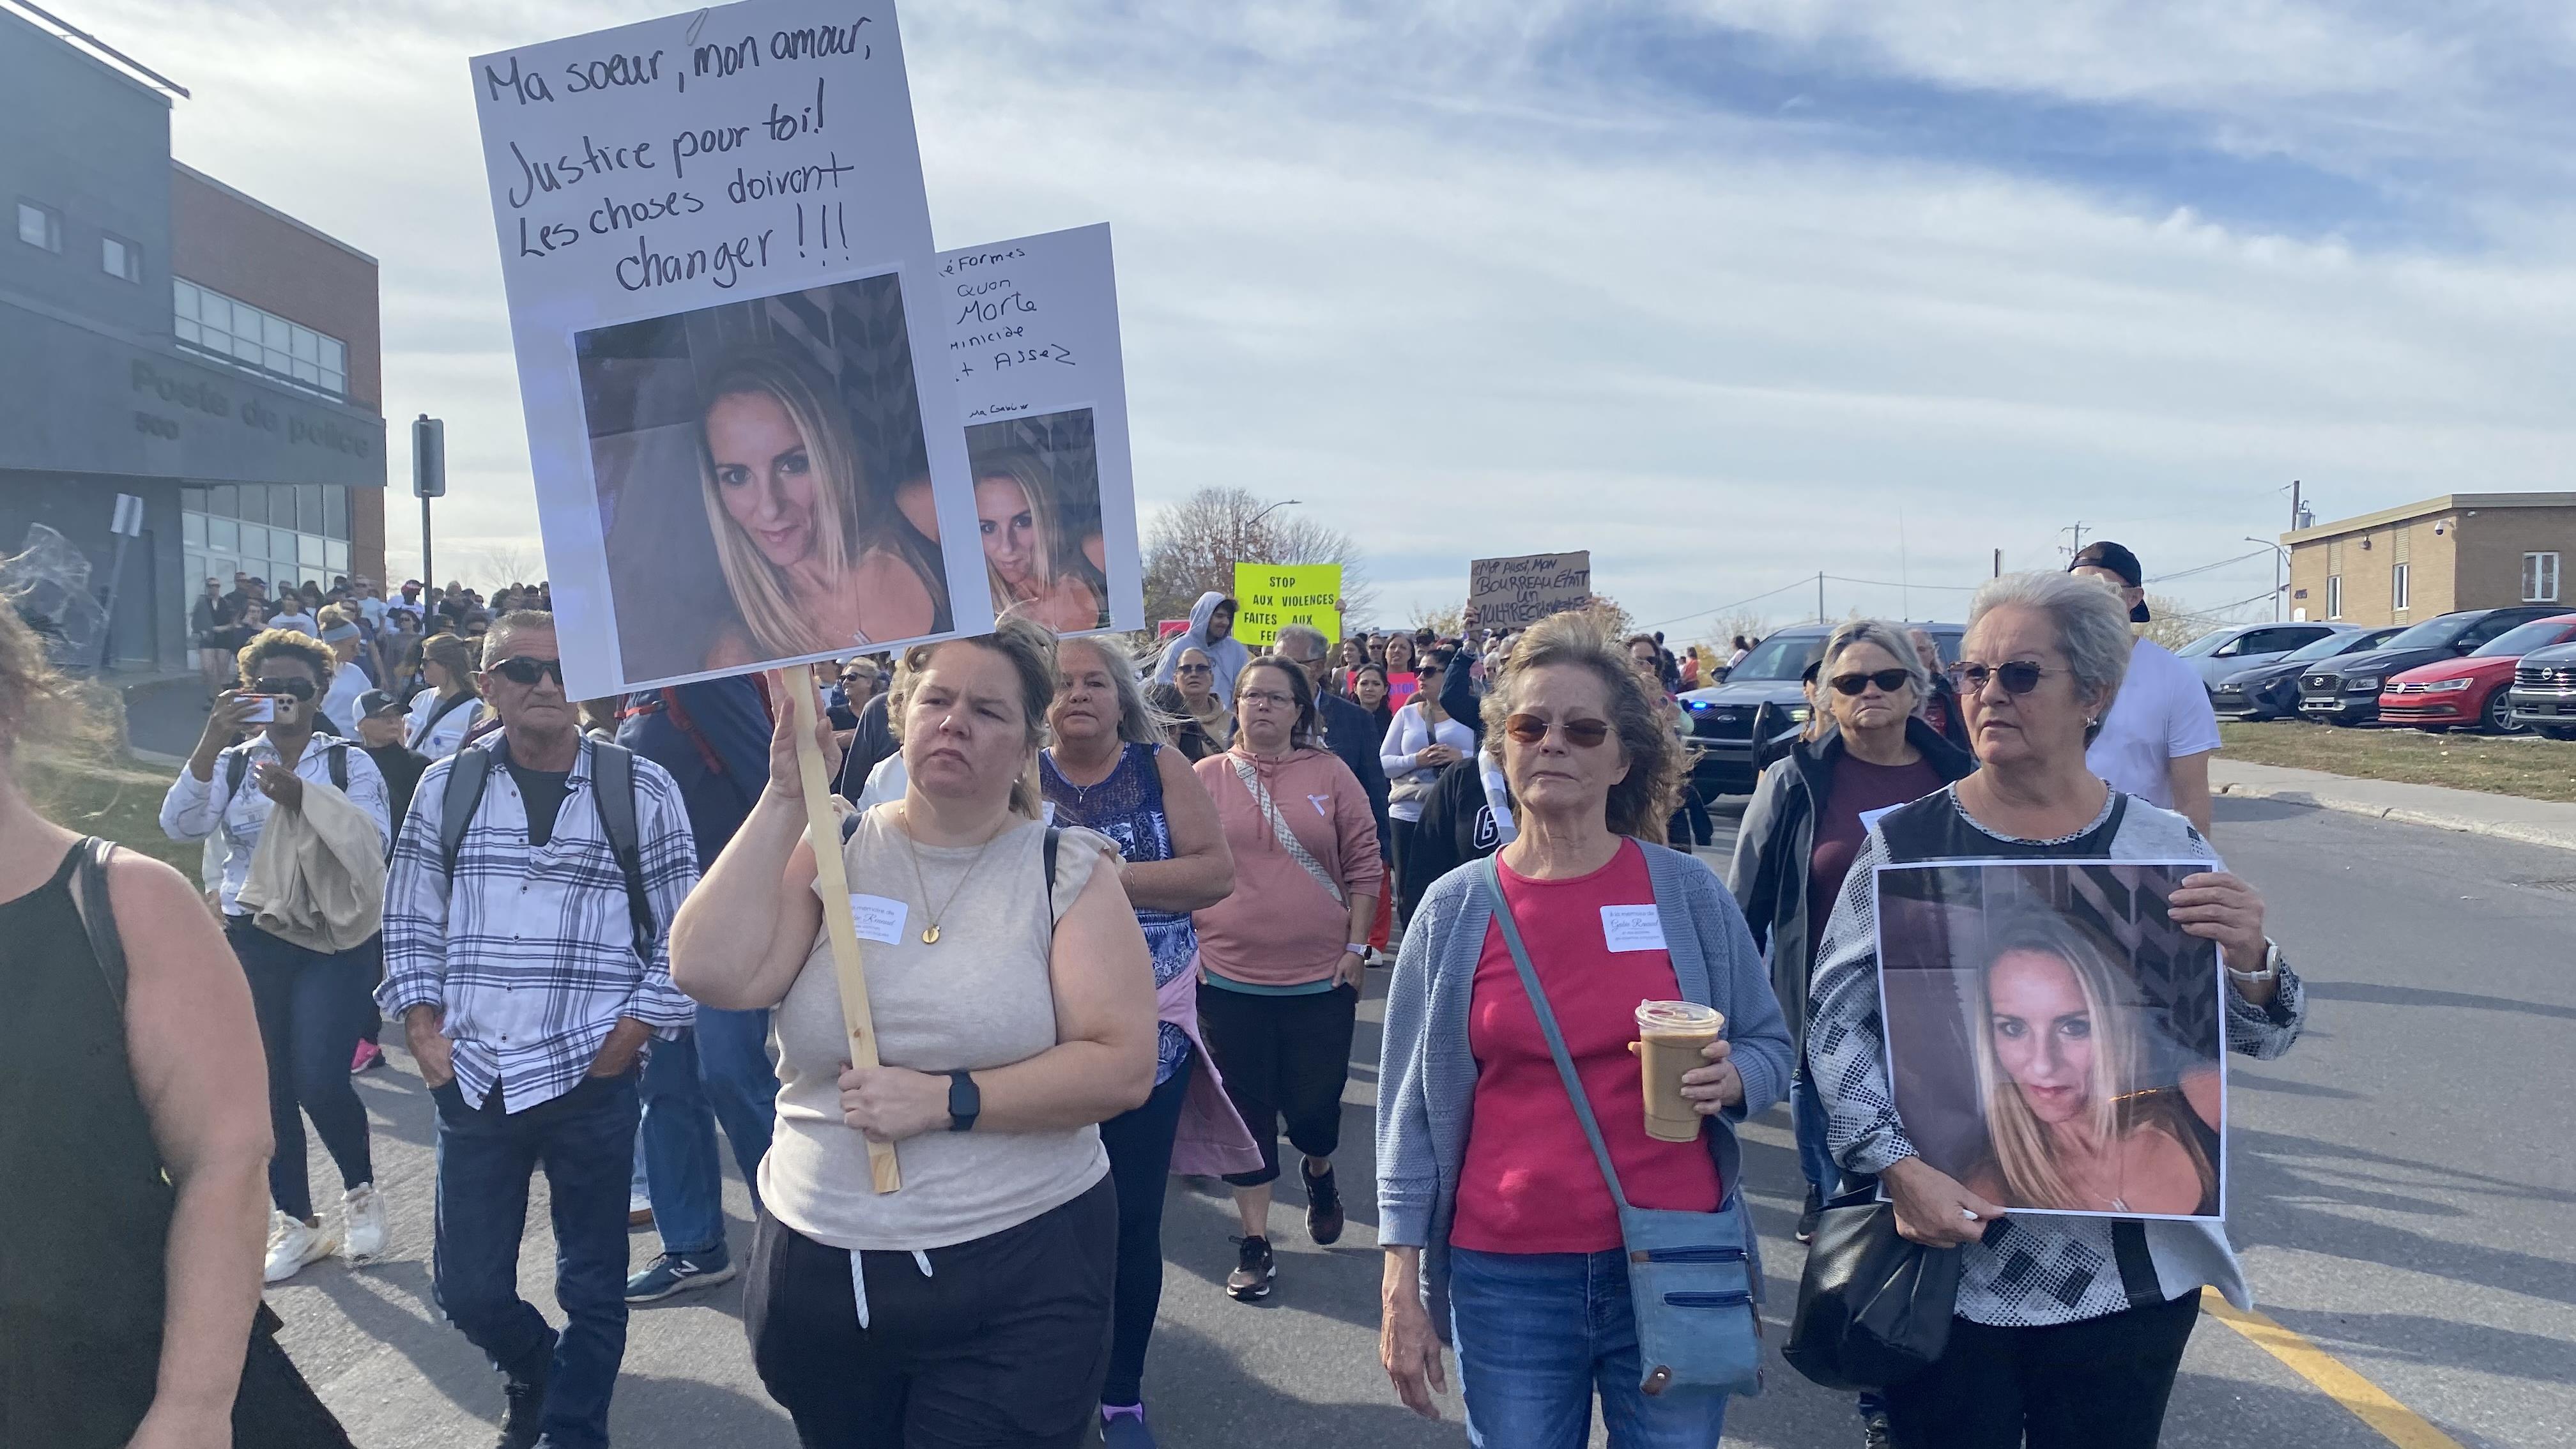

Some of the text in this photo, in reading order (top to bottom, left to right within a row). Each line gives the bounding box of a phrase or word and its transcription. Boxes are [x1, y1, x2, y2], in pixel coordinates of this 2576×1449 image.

[485, 56, 555, 105] Ma
[694, 35, 760, 77] mon
[770, 17, 871, 60] amour,
[509, 77, 825, 208] Justice pour toi!
[519, 218, 579, 257] Les
[589, 191, 704, 234] choses
[615, 235, 774, 291] changer
[241, 397, 279, 432] de
[288, 414, 371, 460] police
[1252, 594, 1335, 607] AUX VIOLENCES
[1269, 576, 1296, 588] STOP
[1244, 612, 1312, 625] FAITES AUX
